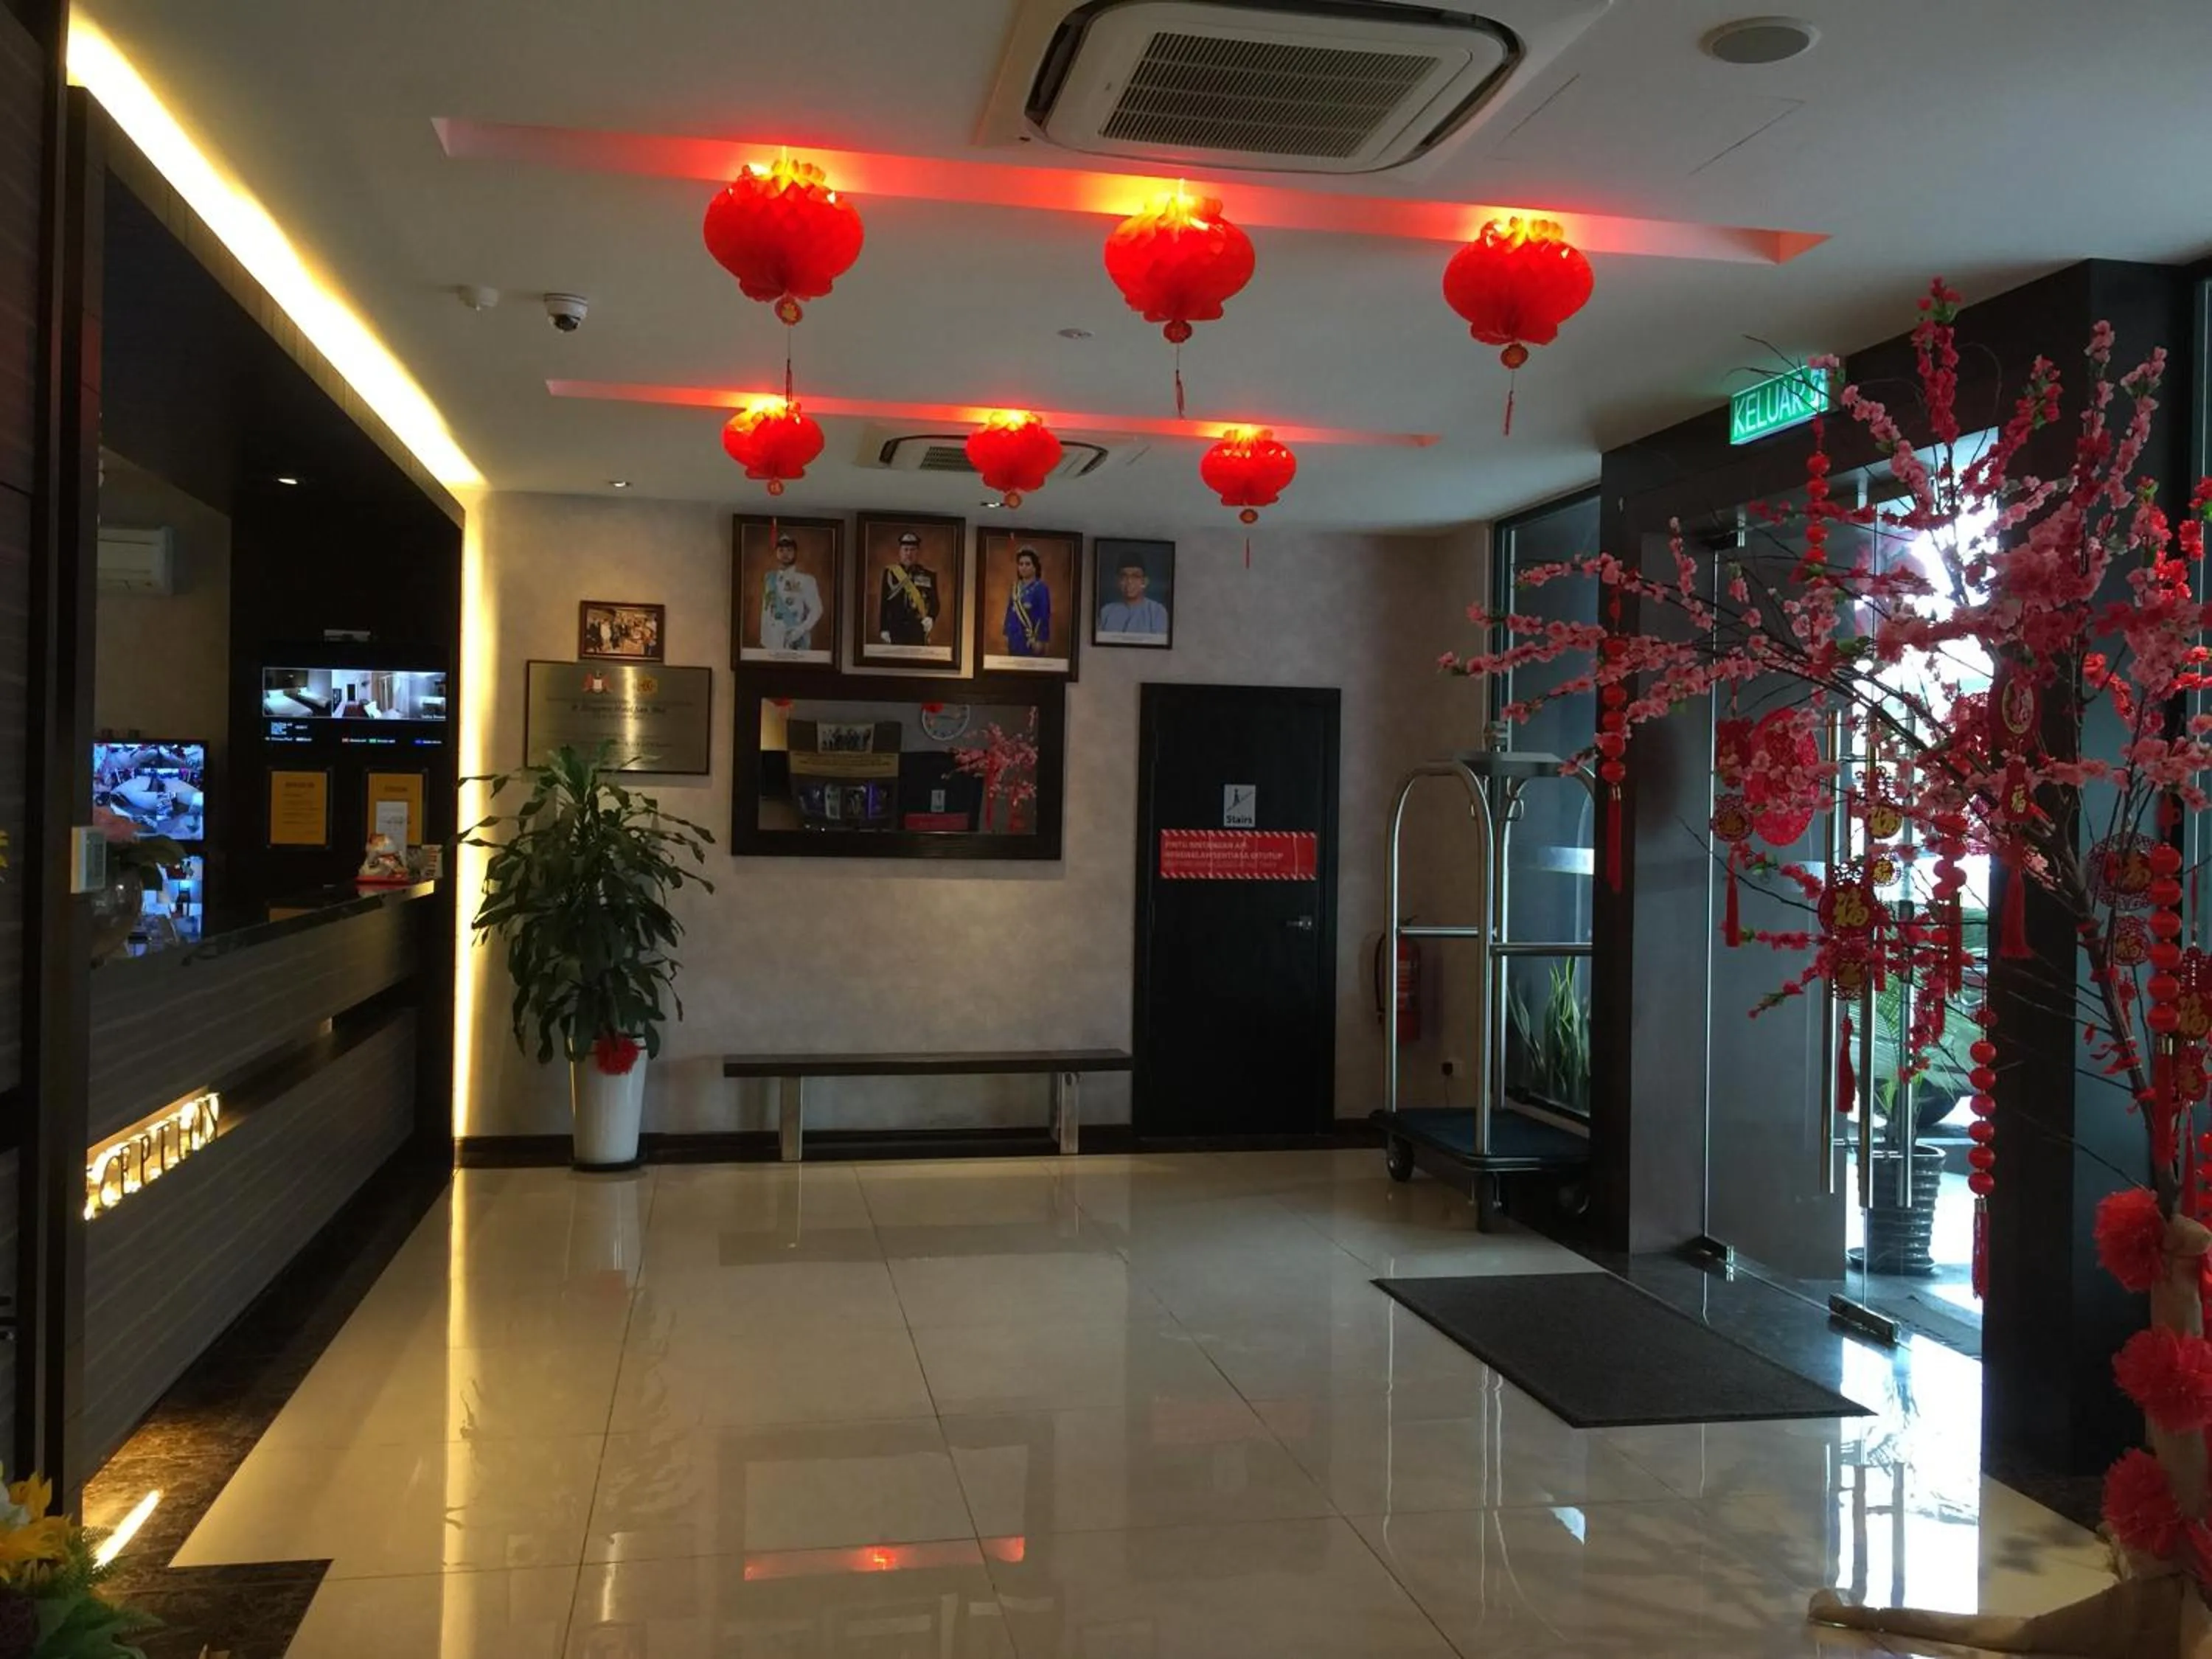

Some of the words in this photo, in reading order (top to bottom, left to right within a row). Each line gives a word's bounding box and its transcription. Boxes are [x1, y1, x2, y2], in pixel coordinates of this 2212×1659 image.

[1733, 375, 1806, 437] KELUAR
[1226, 815, 1253, 824] Stairs
[1833, 887, 1869, 927] 福
